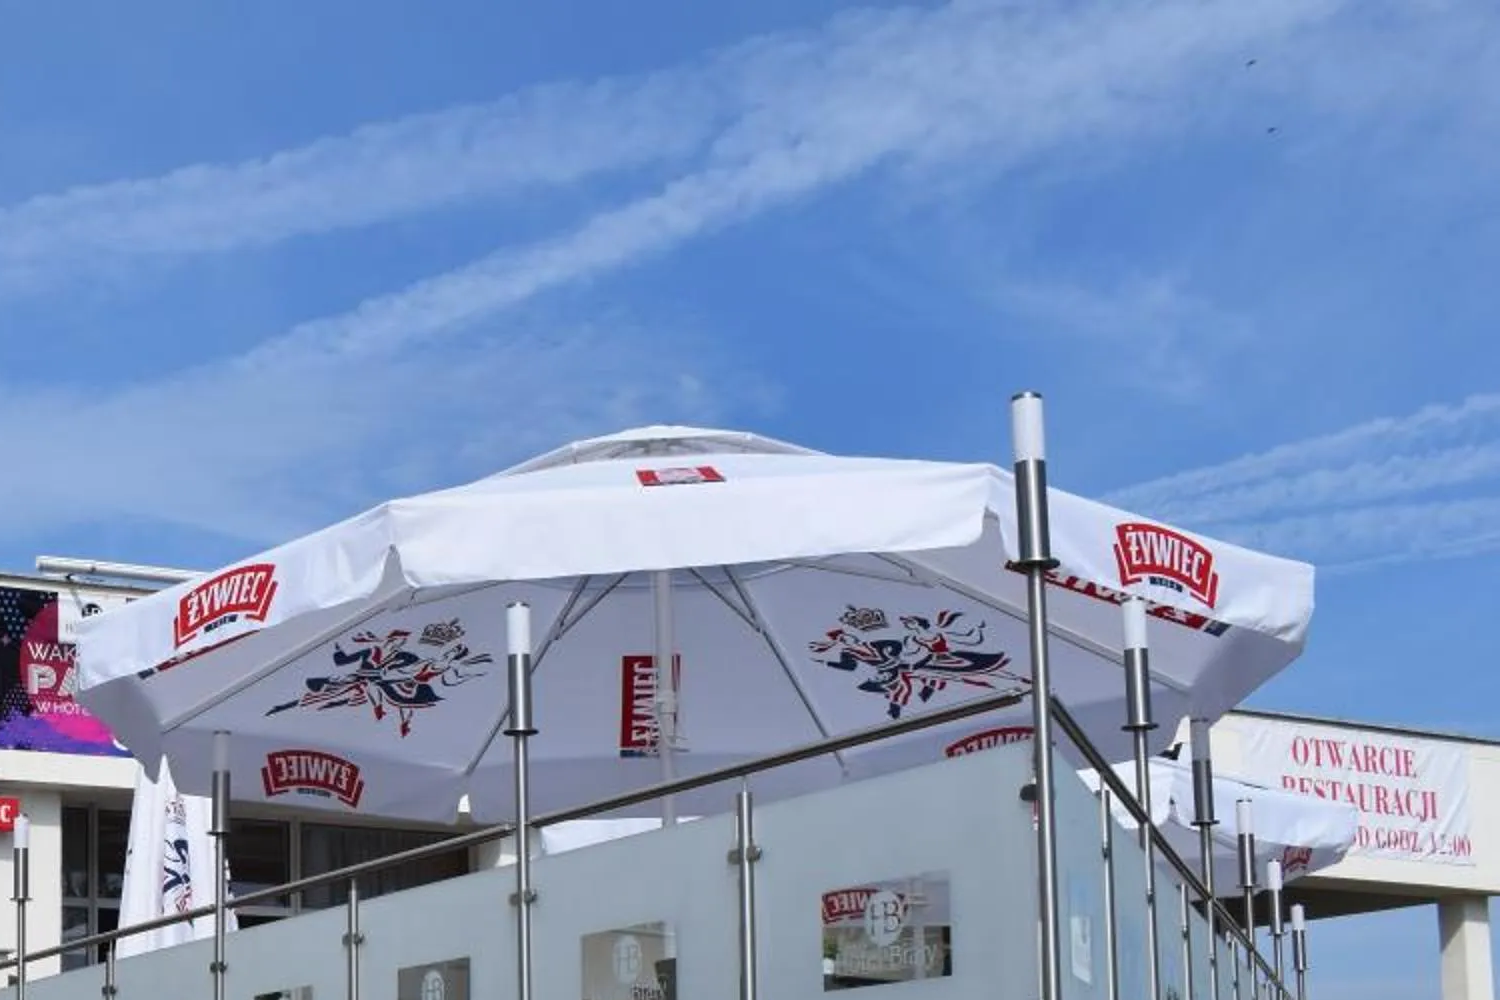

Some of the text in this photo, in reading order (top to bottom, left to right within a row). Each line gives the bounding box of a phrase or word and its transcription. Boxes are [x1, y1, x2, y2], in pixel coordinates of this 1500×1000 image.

[1126, 526, 1206, 586] ŻYWIEC
[187, 571, 267, 627] ŻYWIEC
[27, 640, 77, 661] WAK
[27, 663, 77, 695] PA
[53, 702, 92, 715] HOT
[1290, 735, 1418, 779] OTWARCIE
